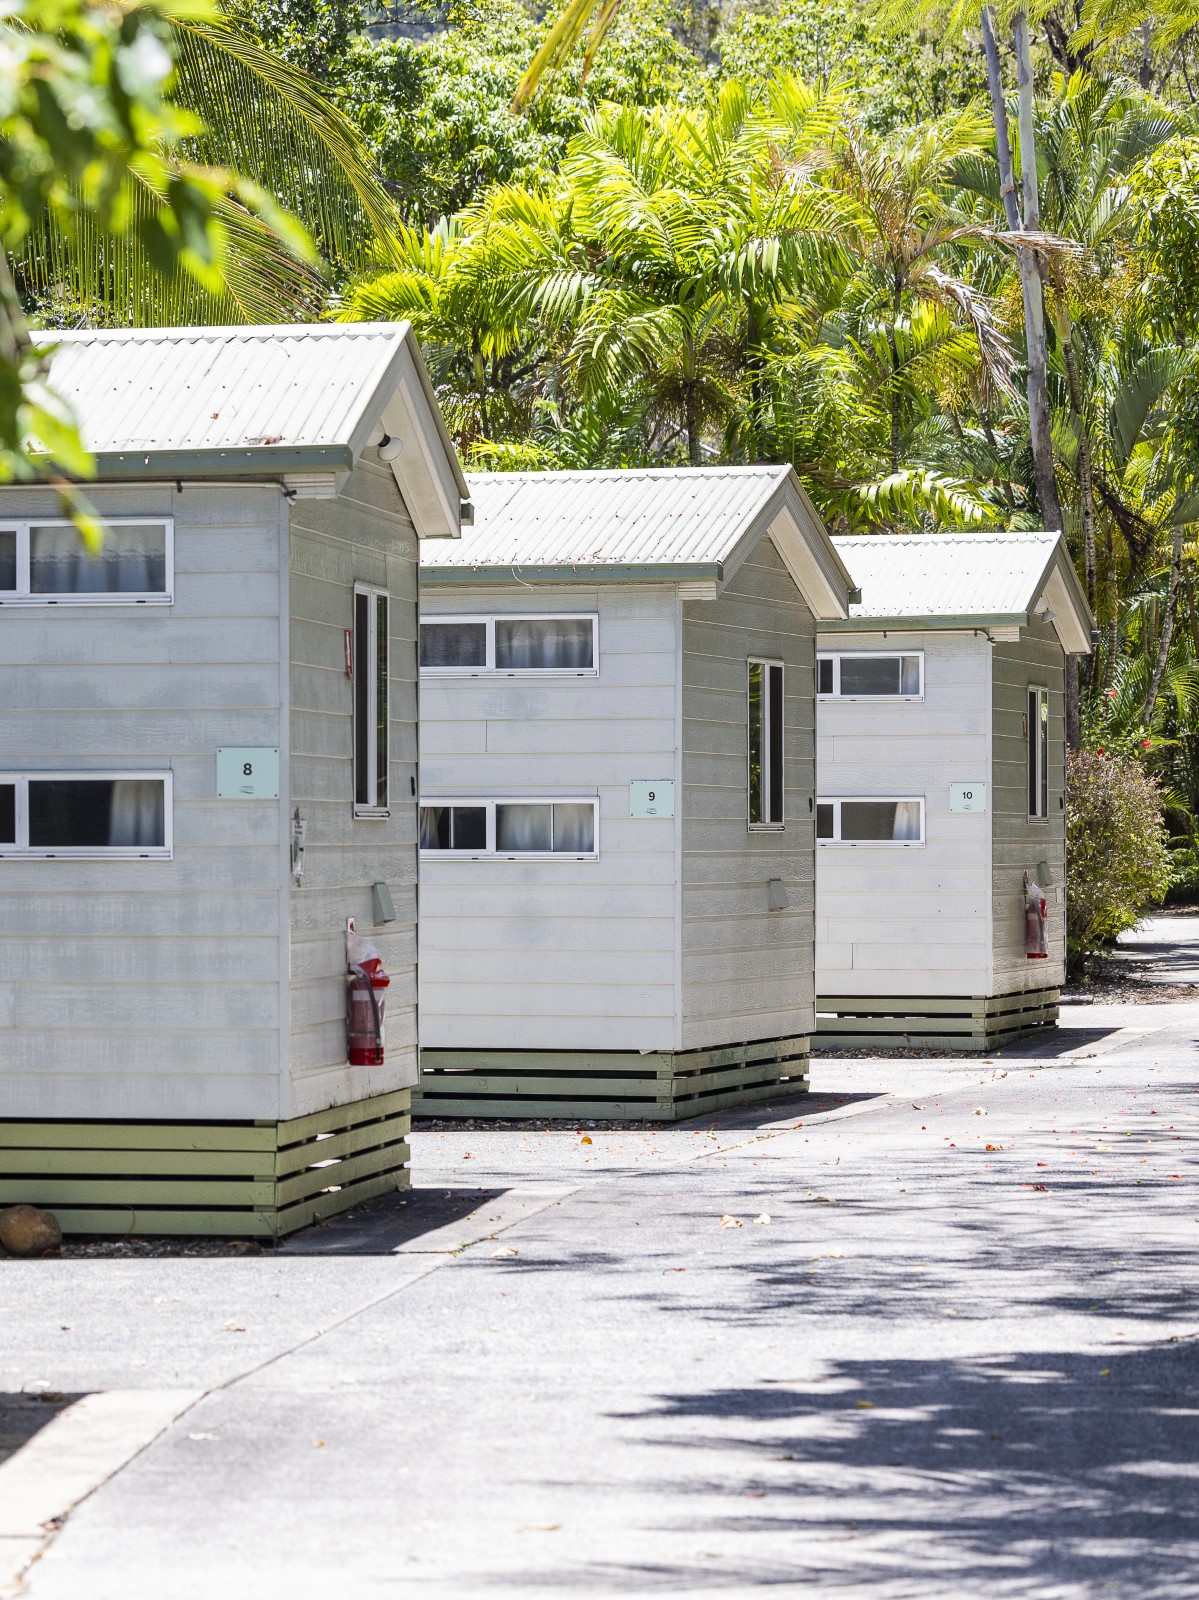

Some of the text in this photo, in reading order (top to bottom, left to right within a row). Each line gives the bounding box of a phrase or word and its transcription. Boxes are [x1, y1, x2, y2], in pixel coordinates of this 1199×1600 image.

[243, 762, 252, 776] 8
[648, 791, 656, 801] 9
[962, 791, 973, 800] 10
